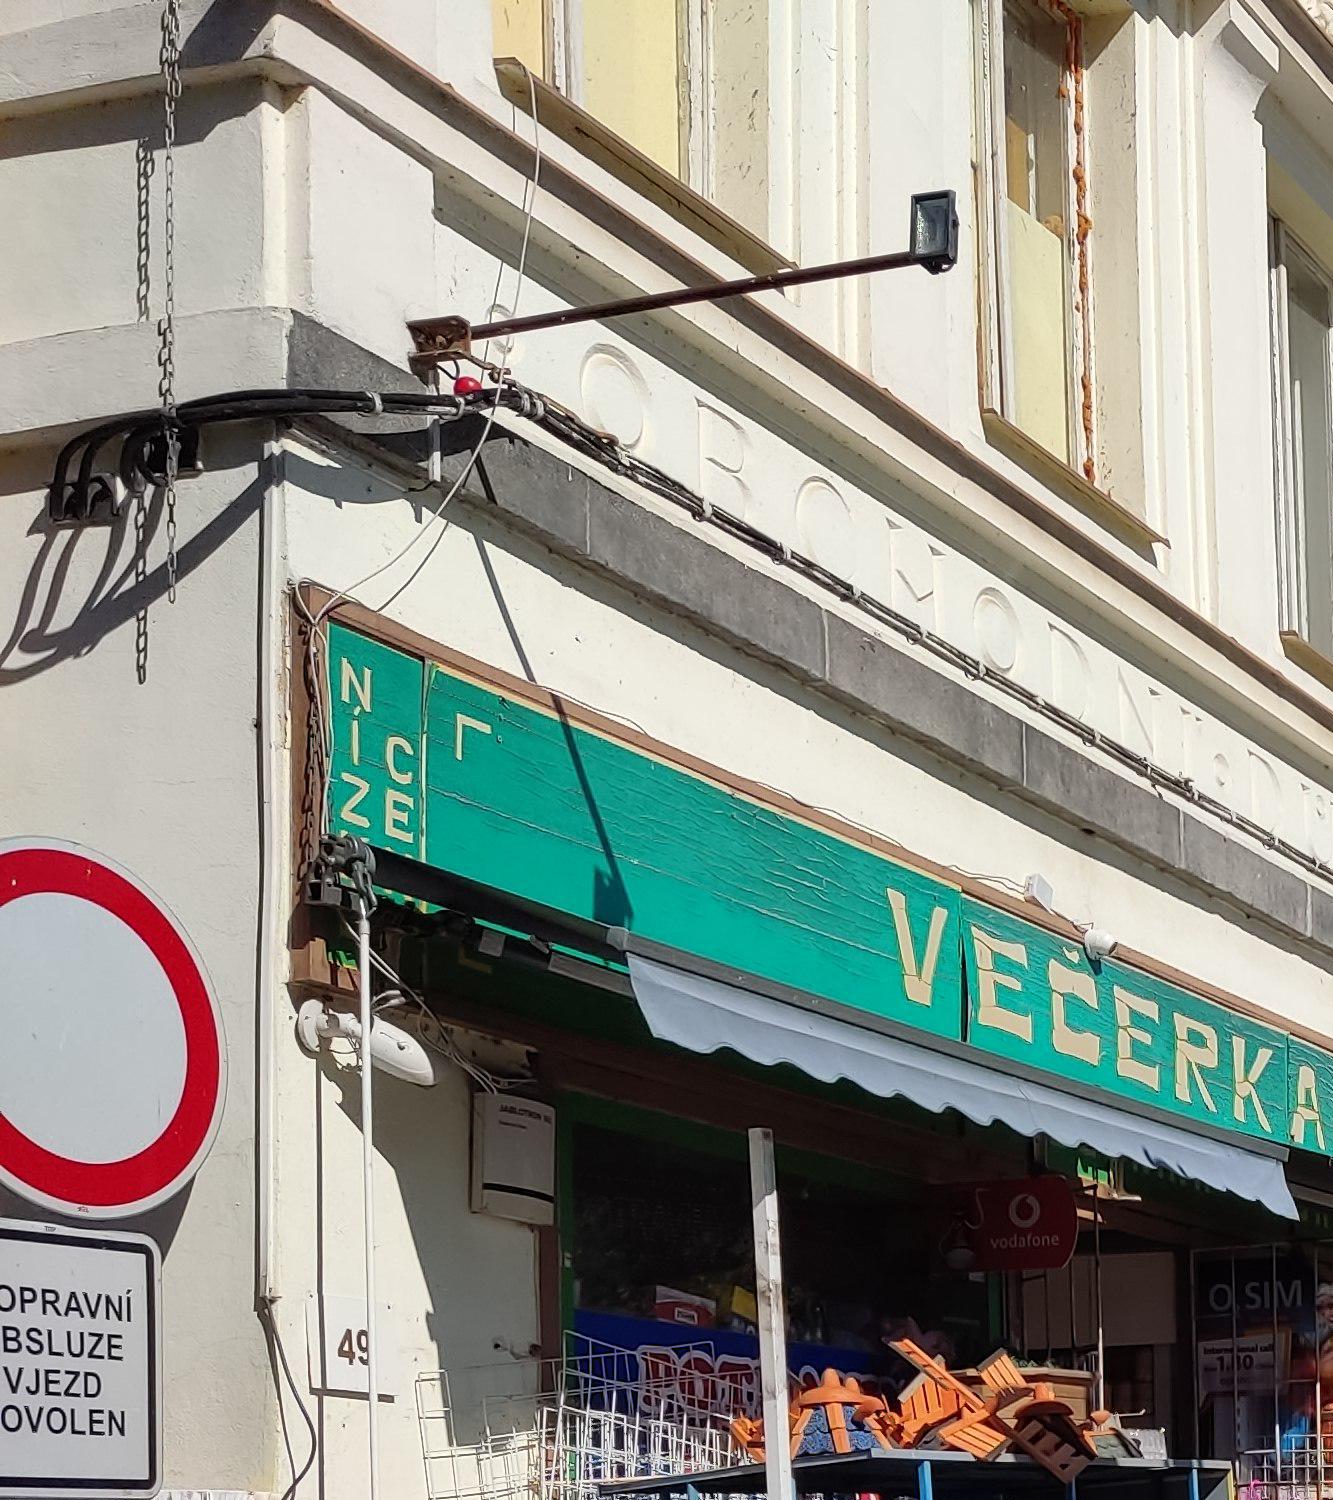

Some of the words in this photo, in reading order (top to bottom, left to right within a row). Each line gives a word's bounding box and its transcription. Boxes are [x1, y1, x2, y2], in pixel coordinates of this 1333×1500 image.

[340, 657, 372, 843] NÍZ
[886, 888, 1326, 1150] VEČERKA
[990, 1232, 1060, 1249] vodafone
[0, 1284, 133, 1322] OPRAVNÍ
[1244, 1279, 1303, 1311] SIM
[2, 1325, 124, 1361] BSLUZE
[338, 1328, 370, 1366] 49
[3, 1366, 102, 1398] VJEZD
[1, 1404, 126, 1437] OVOLEN
